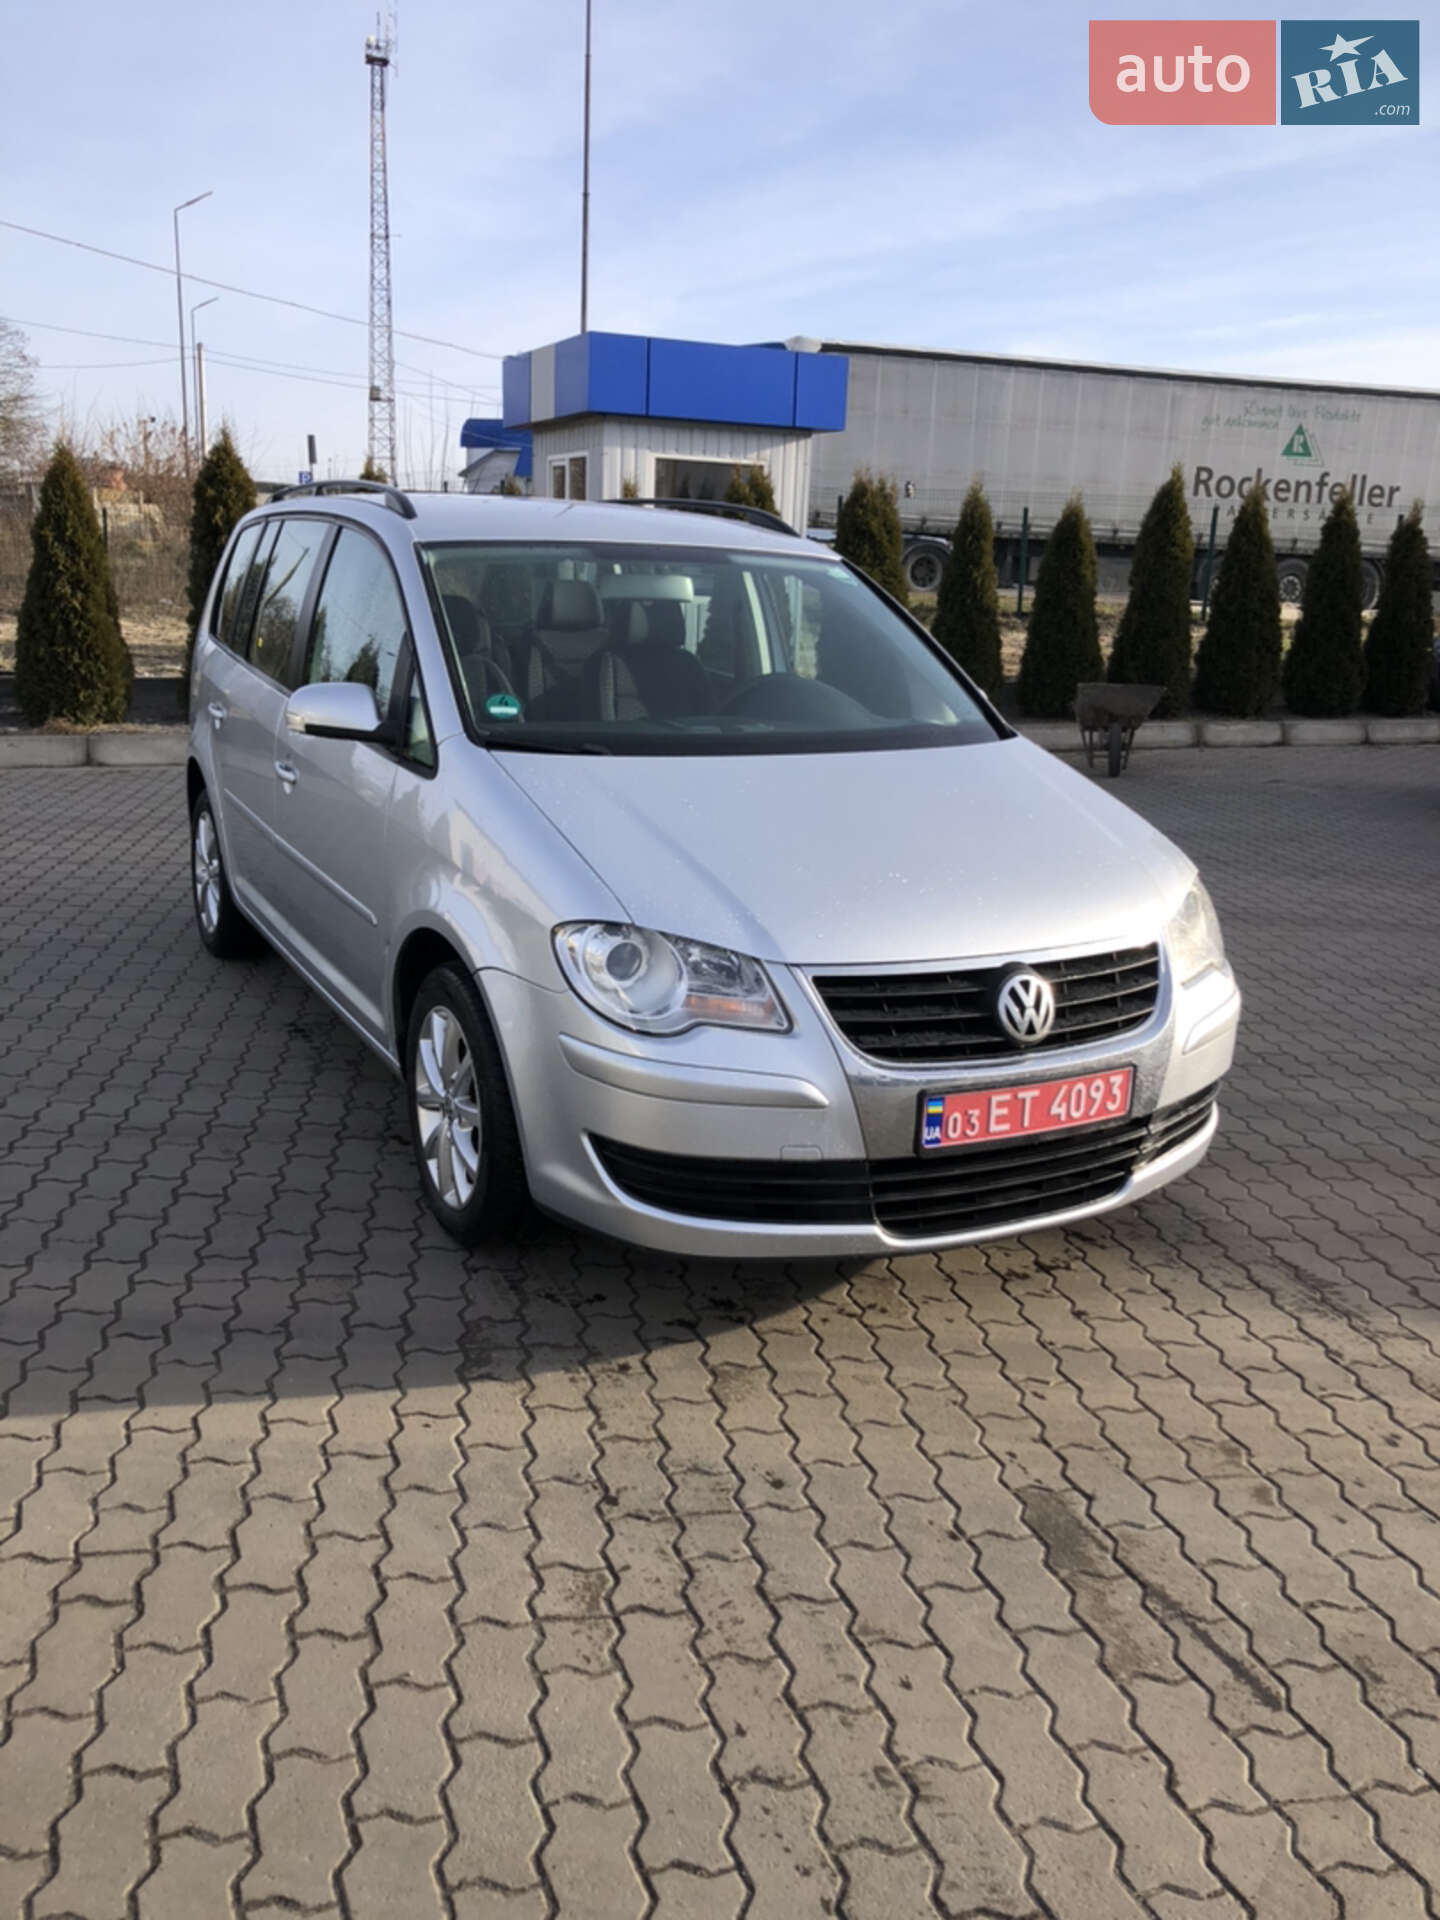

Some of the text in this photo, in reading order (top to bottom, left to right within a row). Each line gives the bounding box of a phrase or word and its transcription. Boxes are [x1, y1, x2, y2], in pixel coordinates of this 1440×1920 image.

[1192, 466, 1401, 508] Rockenfeller
[924, 1126, 941, 1141] UA
[1050, 1074, 1125, 1122] 4093
